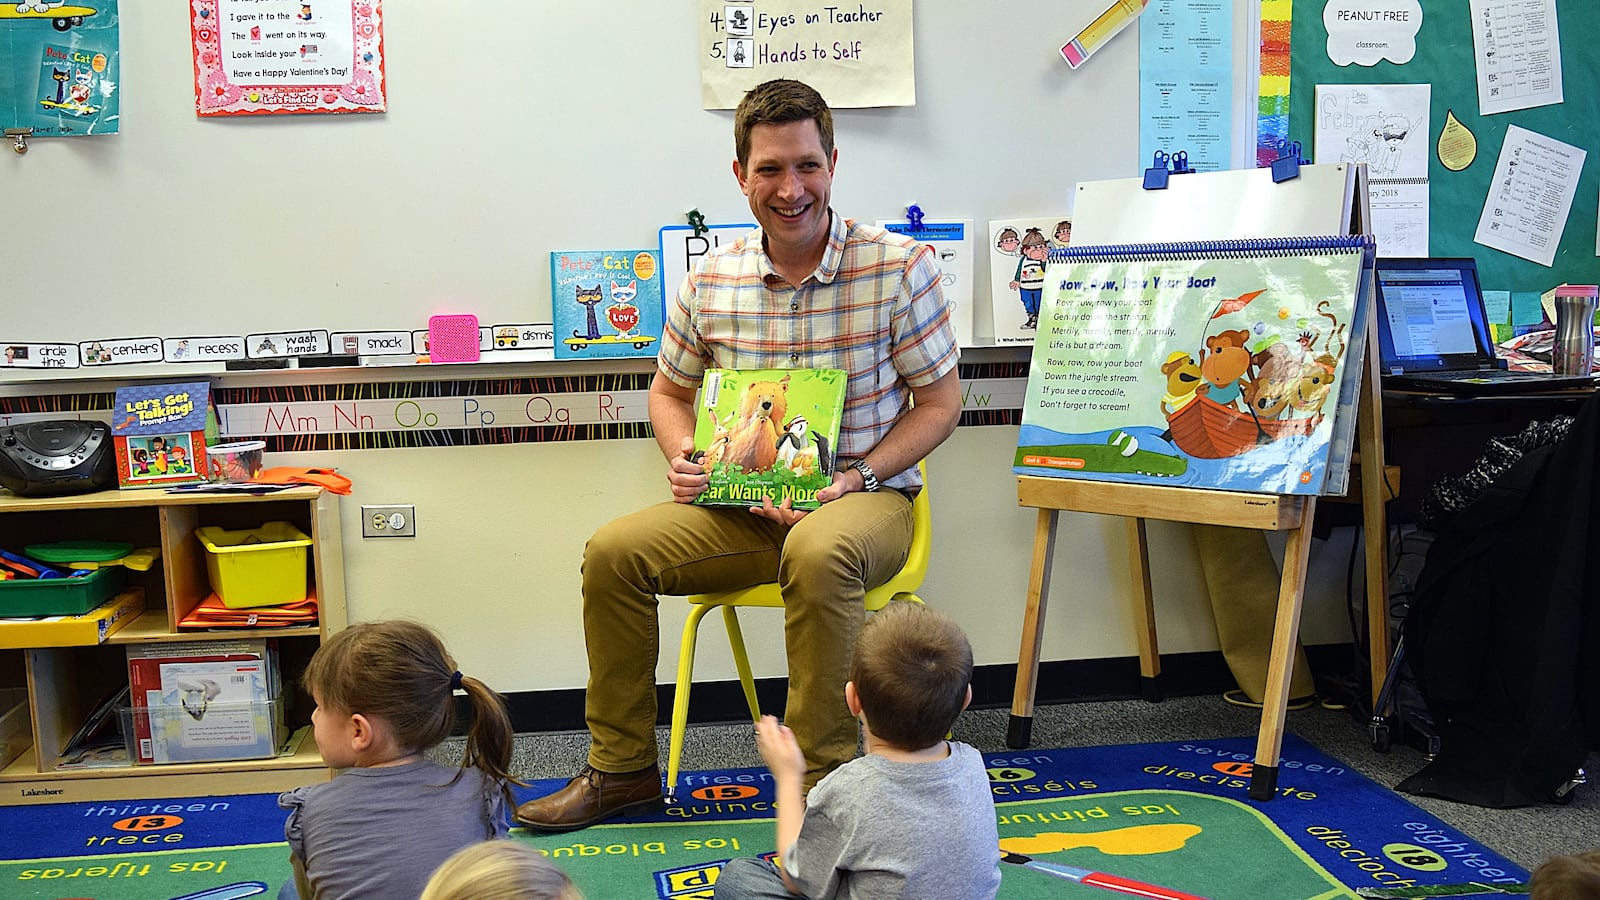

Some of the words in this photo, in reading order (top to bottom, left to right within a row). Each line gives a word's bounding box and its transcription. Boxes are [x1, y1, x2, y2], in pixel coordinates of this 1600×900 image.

[236, 14, 256, 23] gave
[258, 13, 264, 21] it
[266, 13, 275, 21] to
[710, 12, 725, 32] 4.
[758, 13, 795, 36] Eyes
[805, 14, 820, 24] on
[824, 4, 884, 25] Teacher
[1337, 10, 1381, 21] PEANUT
[1383, 10, 1409, 21] FREE
[232, 32, 246, 40] The
[298, 31, 308, 39] its
[310, 32, 328, 40] way.
[1355, 41, 1390, 49] classroom.
[46, 47, 68, 60] Pete
[74, 52, 91, 64] Cat
[232, 51, 253, 59] Look
[254, 50, 277, 58] inside
[278, 51, 297, 60] your
[709, 41, 726, 60] 5.
[758, 43, 807, 65] Hands
[812, 43, 827, 59] to
[832, 41, 862, 61] Self
[233, 69, 253, 78] Have
[262, 69, 288, 79] Happy
[289, 67, 330, 77] Valentine's
[331, 67, 349, 78] Day!
[283, 95, 301, 104] Find
[301, 95, 317, 104] Out
[1381, 187, 1399, 197] 2018
[561, 256, 593, 271] Pete
[603, 255, 630, 271] Cat
[1187, 276, 1217, 288] Boat
[612, 313, 635, 324] LOVE
[285, 331, 317, 344] wash
[522, 330, 554, 342] dismis
[1146, 328, 1177, 337] merrily,
[286, 343, 317, 354] hands
[367, 336, 403, 349] snack
[1049, 341, 1064, 349] Life
[39, 345, 68, 357] circle
[112, 343, 159, 356] centers
[198, 343, 239, 355] recess
[41, 357, 66, 368] time
[1047, 358, 1066, 368] Row,
[1068, 360, 1085, 368] row,
[1104, 361, 1122, 369] your
[1124, 360, 1143, 368] boat
[1045, 372, 1067, 380] Down
[1082, 373, 1109, 384] jungle
[1110, 374, 1139, 382] stream.
[1043, 386, 1050, 394] If
[1051, 387, 1065, 396] you
[1087, 388, 1126, 397] crocodile,
[125, 398, 161, 413] Let's
[164, 392, 190, 406] Get
[1040, 400, 1061, 409] Don't
[1063, 401, 1087, 412] forget
[1089, 402, 1098, 410] to
[1099, 403, 1130, 412] scream!
[136, 400, 194, 420] Talking!
[264, 406, 318, 433] Mm
[334, 403, 374, 430] Nn
[395, 400, 438, 428] Oo
[463, 398, 495, 428] Pp
[526, 396, 570, 427] Qq
[598, 394, 625, 421] Rr
[139, 416, 168, 427] Prompt
[168, 414, 183, 422] Box
[1048, 458, 1082, 467] Transportation
[703, 486, 725, 499] ear
[729, 483, 776, 501] Wants
[1178, 744, 1345, 776] seveeen
[992, 778, 1099, 796] ciséis
[1143, 764, 1318, 801] dieciste
[21, 787, 64, 797] Lakeshore
[704, 787, 742, 799] 15
[84, 801, 230, 817] thirteen
[1121, 803, 1181, 817] las
[999, 806, 1111, 825] pintur
[126, 817, 167, 829] 13
[85, 833, 185, 847] trece
[683, 837, 740, 851] los
[536, 841, 666, 858] bloqu
[1306, 825, 1418, 888] diecioch
[1390, 849, 1439, 866] 18
[17, 862, 150, 881] tijeras
[169, 860, 228, 874] las
